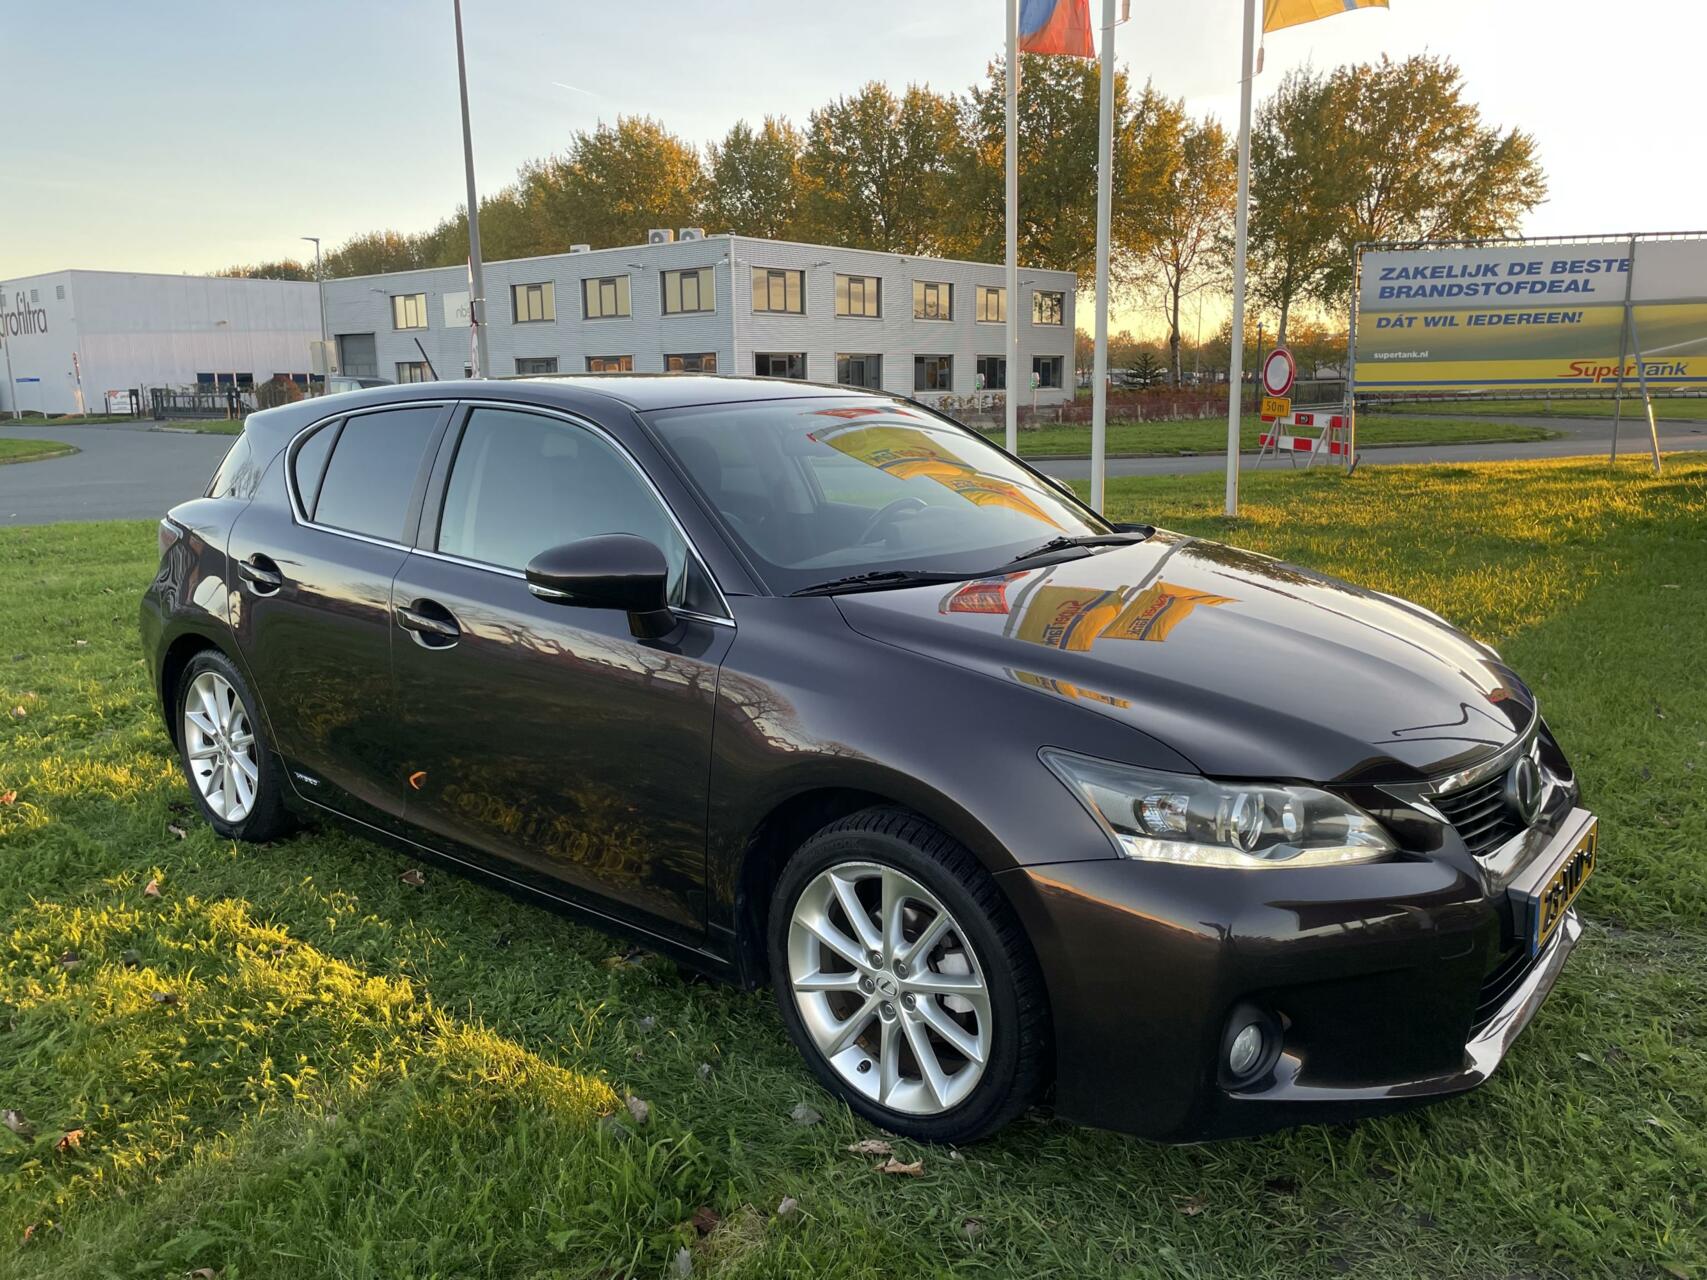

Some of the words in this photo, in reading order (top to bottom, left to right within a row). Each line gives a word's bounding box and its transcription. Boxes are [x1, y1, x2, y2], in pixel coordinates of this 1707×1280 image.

[1378, 263, 1500, 281] ZAKELIJK
[1507, 261, 1544, 276] DE
[1550, 258, 1631, 274] BESTE
[1378, 278, 1596, 299] BRANDSTOFDEAL
[1376, 314, 1418, 329] DÁT
[1423, 315, 1459, 328] WIL
[1466, 312, 1583, 326] IEDEREEN!
[1373, 350, 1429, 360] supertank.nl
